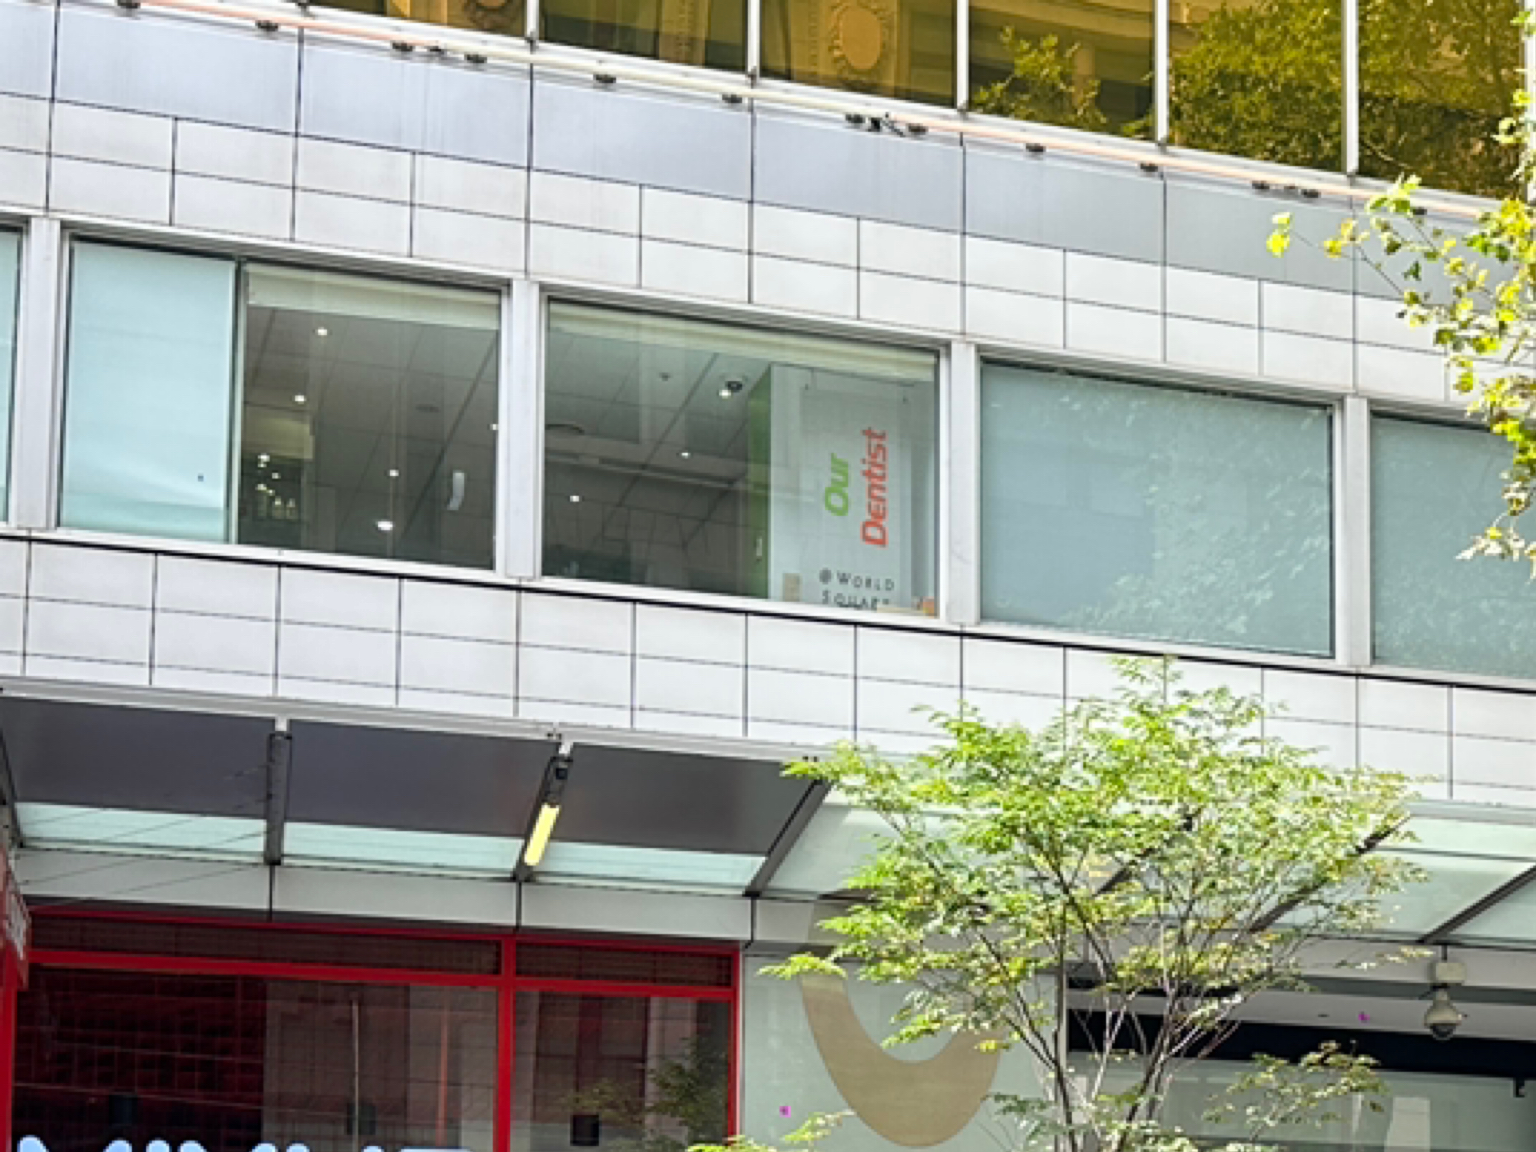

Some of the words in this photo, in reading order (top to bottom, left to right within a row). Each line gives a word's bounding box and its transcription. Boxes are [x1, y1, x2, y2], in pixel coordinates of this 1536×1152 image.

[825, 453, 849, 517] Our
[861, 427, 889, 548] Dentist
[836, 569, 895, 591] WORLD
